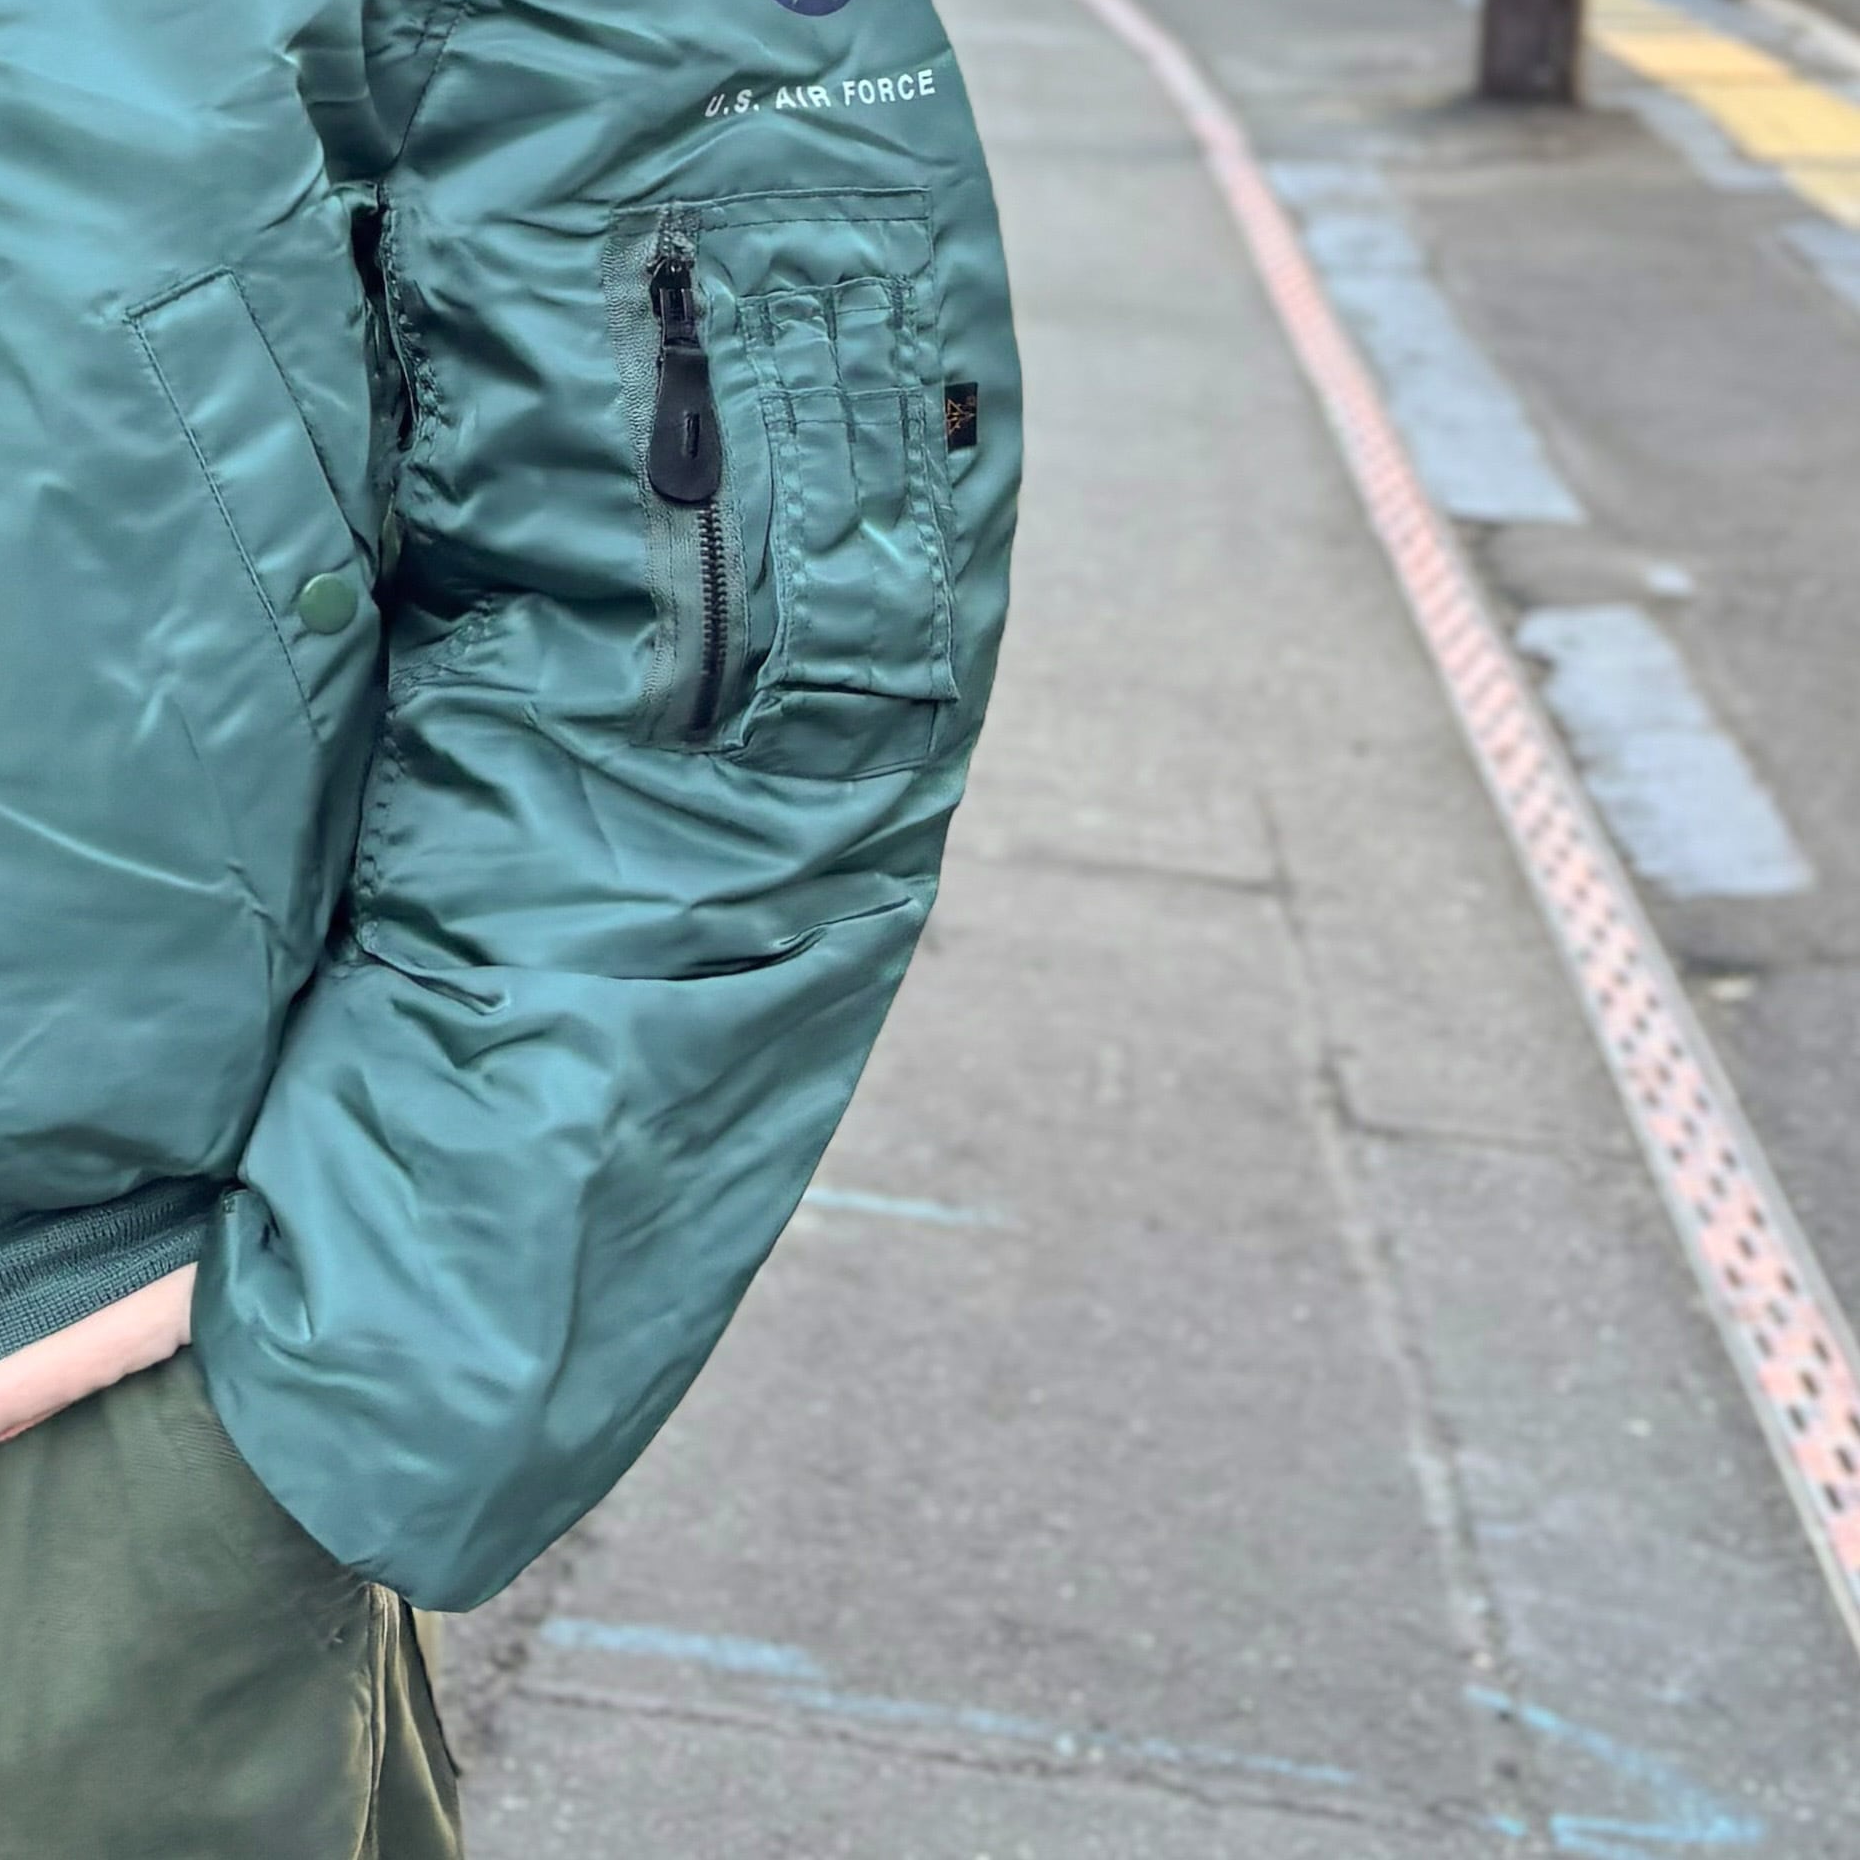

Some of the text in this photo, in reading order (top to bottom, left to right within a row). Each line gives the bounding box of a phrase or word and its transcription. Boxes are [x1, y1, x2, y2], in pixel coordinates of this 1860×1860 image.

[704, 69, 936, 118] U.S. AIR FORCE
